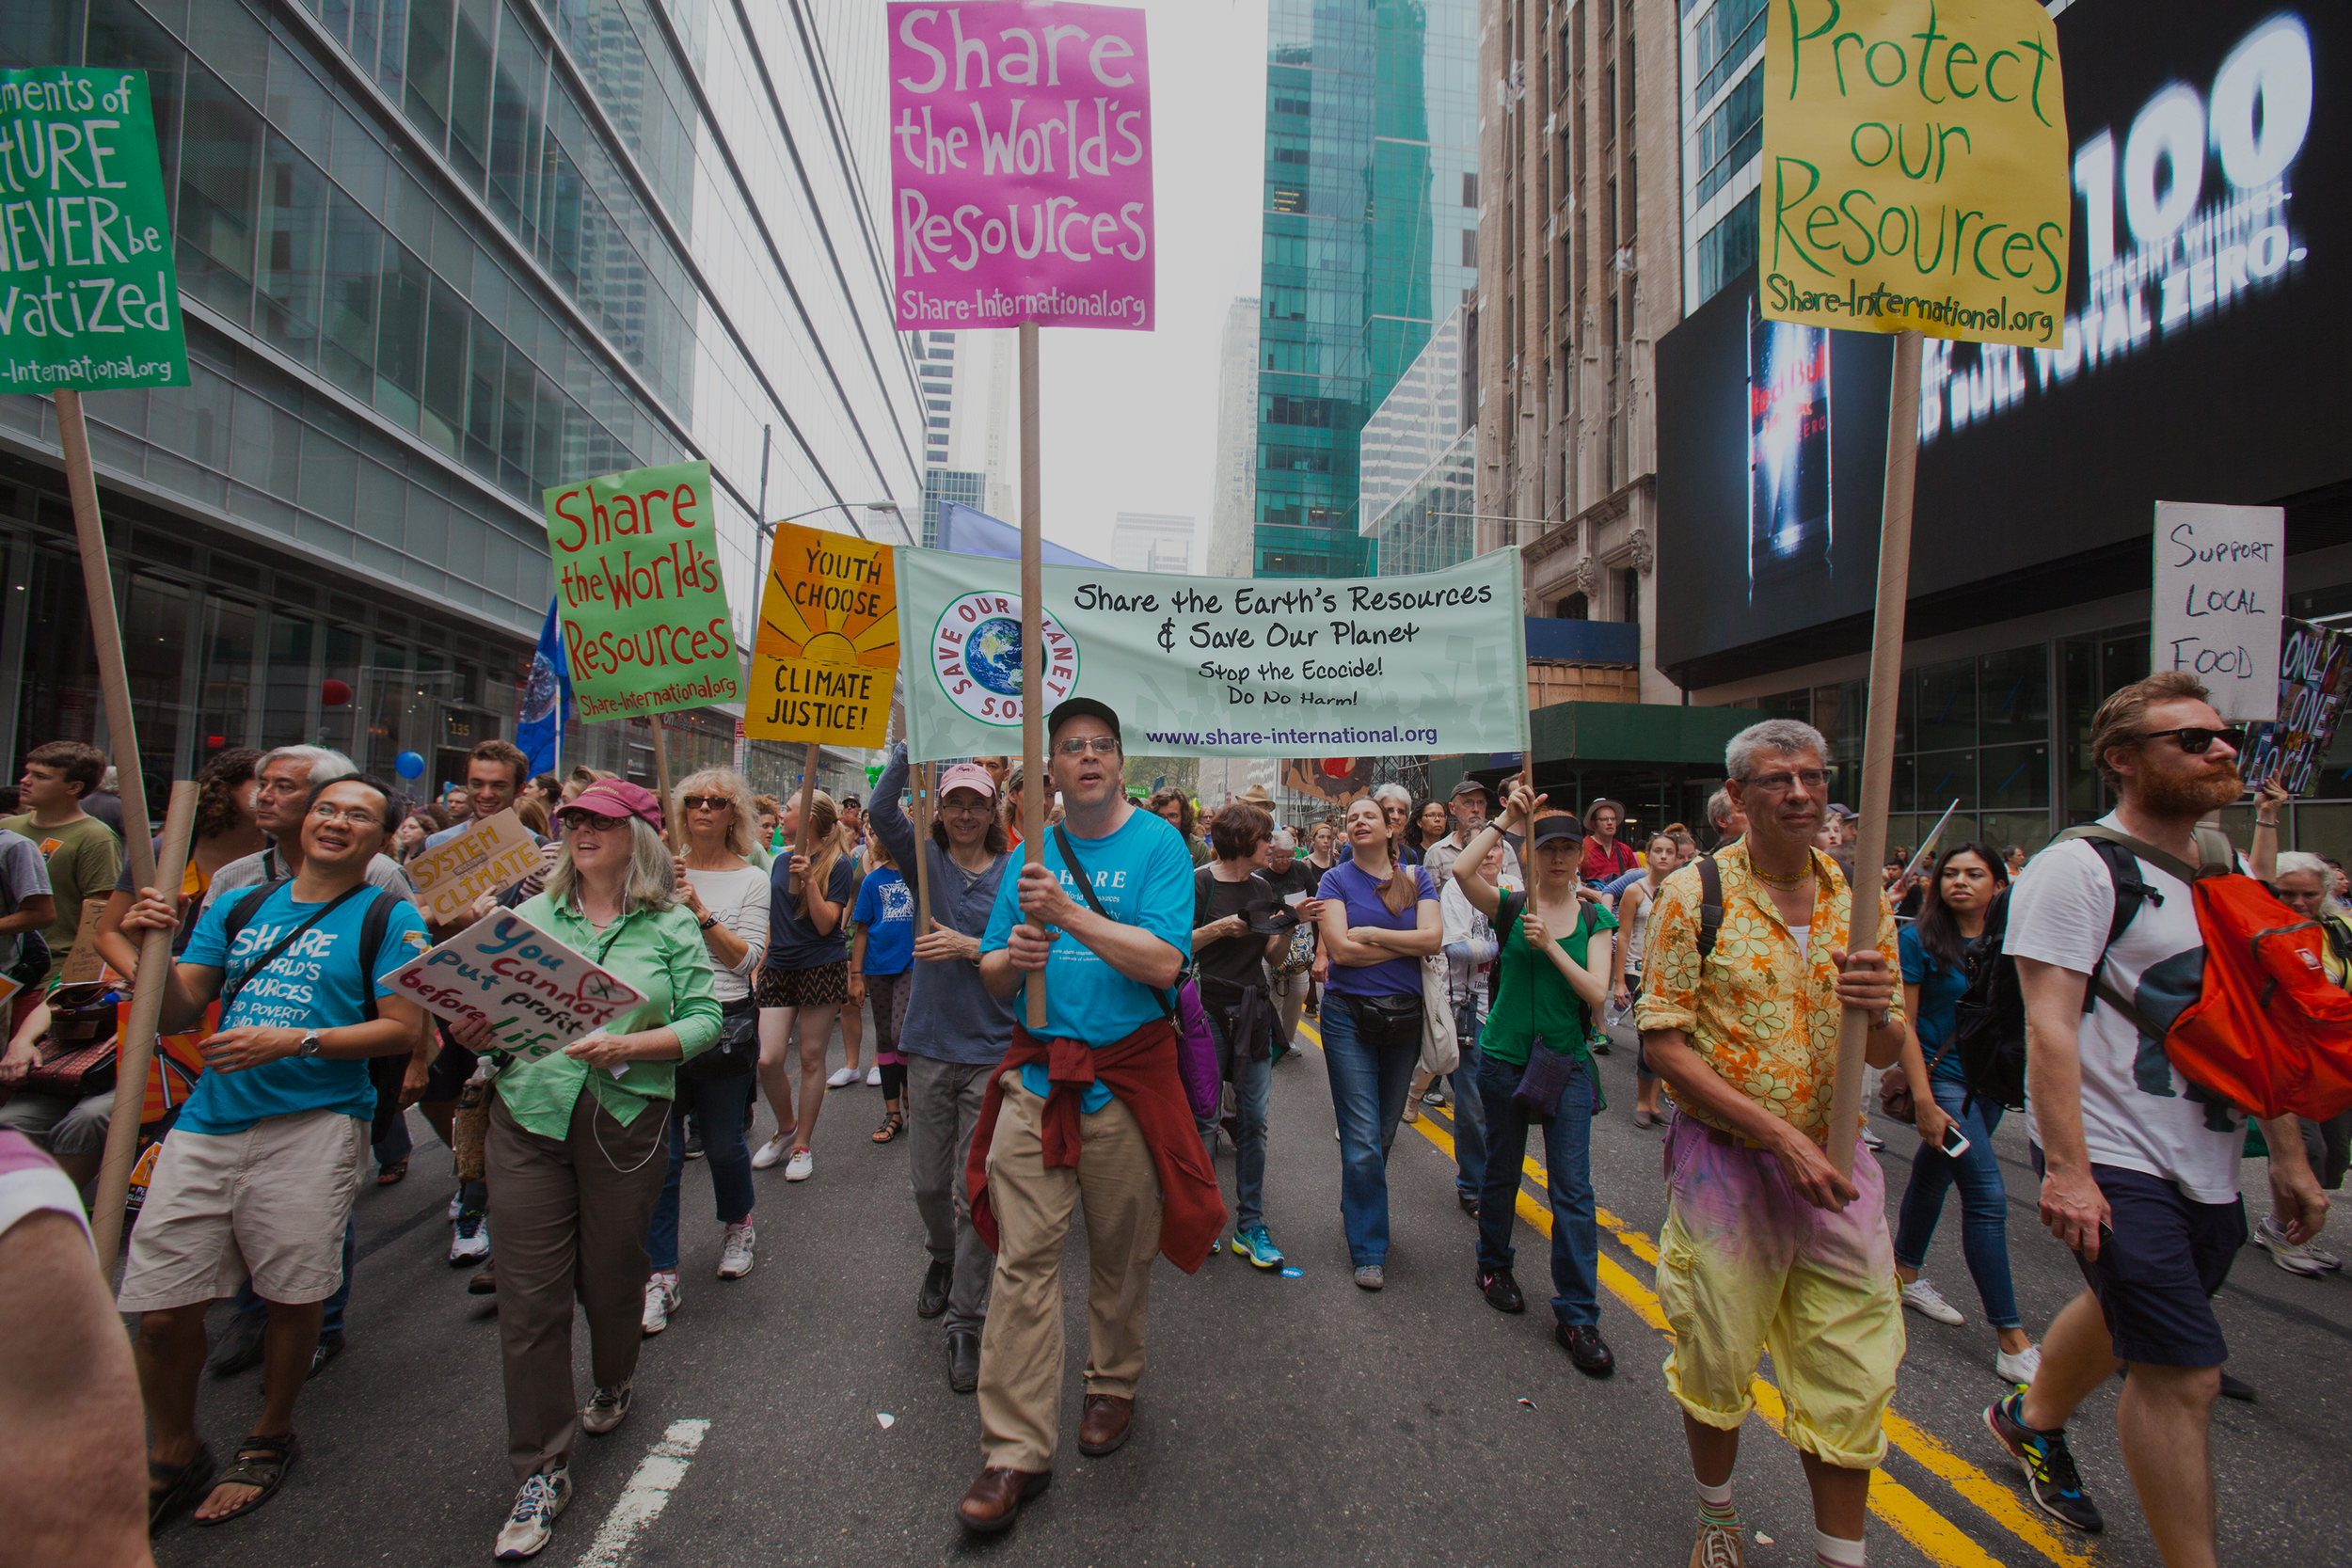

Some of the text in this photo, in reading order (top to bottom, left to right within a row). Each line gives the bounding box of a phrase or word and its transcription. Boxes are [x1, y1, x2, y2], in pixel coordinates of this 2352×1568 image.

[898, 8, 1135, 93] Share
[1788, 0, 2054, 128] Protect
[0, 71, 135, 115] ments of
[894, 97, 1143, 180] the World's
[1851, 121, 1971, 183] our
[2072, 9, 2313, 280] 100
[124, 214, 162, 255] be
[899, 188, 1146, 277] Resources
[1773, 155, 2063, 295] Resources
[2090, 238, 2176, 302] PERCENT
[902, 287, 1146, 326] Share-International.org
[1766, 272, 2054, 342] Share-International.org
[1950, 352, 2026, 423] BULL
[2161, 224, 2308, 325] ZERO.
[555, 483, 697, 552] Share
[805, 544, 882, 585] YOUTH
[2170, 523, 2274, 567] SUPPORT
[562, 540, 718, 610] the World's
[795, 580, 881, 617] CHOOSE
[1074, 584, 1493, 614] Share the Earth's Resources
[2185, 583, 2265, 617] LOCAL
[564, 617, 729, 681] Resources
[939, 597, 1073, 698] SAVE OUR LANET
[1157, 617, 1421, 653] & Save Our Planet
[2169, 637, 2253, 679] FOOD
[2281, 629, 2342, 684] ONLY
[774, 664, 872, 700] CLIMATE
[1199, 657, 1384, 684] Stop the Ecocide!
[580, 674, 737, 716] Share-International.org
[767, 698, 867, 731] JUSTICE!
[980, 697, 1024, 719] S.O.
[1229, 685, 1359, 706] Do No Harm!
[2289, 686, 2338, 738] ONE
[451, 722, 469, 736] 135
[1145, 723, 1438, 746] www.share-international.org
[413, 826, 501, 889] SYSTEM
[435, 842, 540, 914] CLIMATE
[1049, 869, 1127, 888] HRE
[476, 916, 564, 972] You
[250, 1002, 310, 1022] POVERTY
[399, 968, 485, 1021] before
